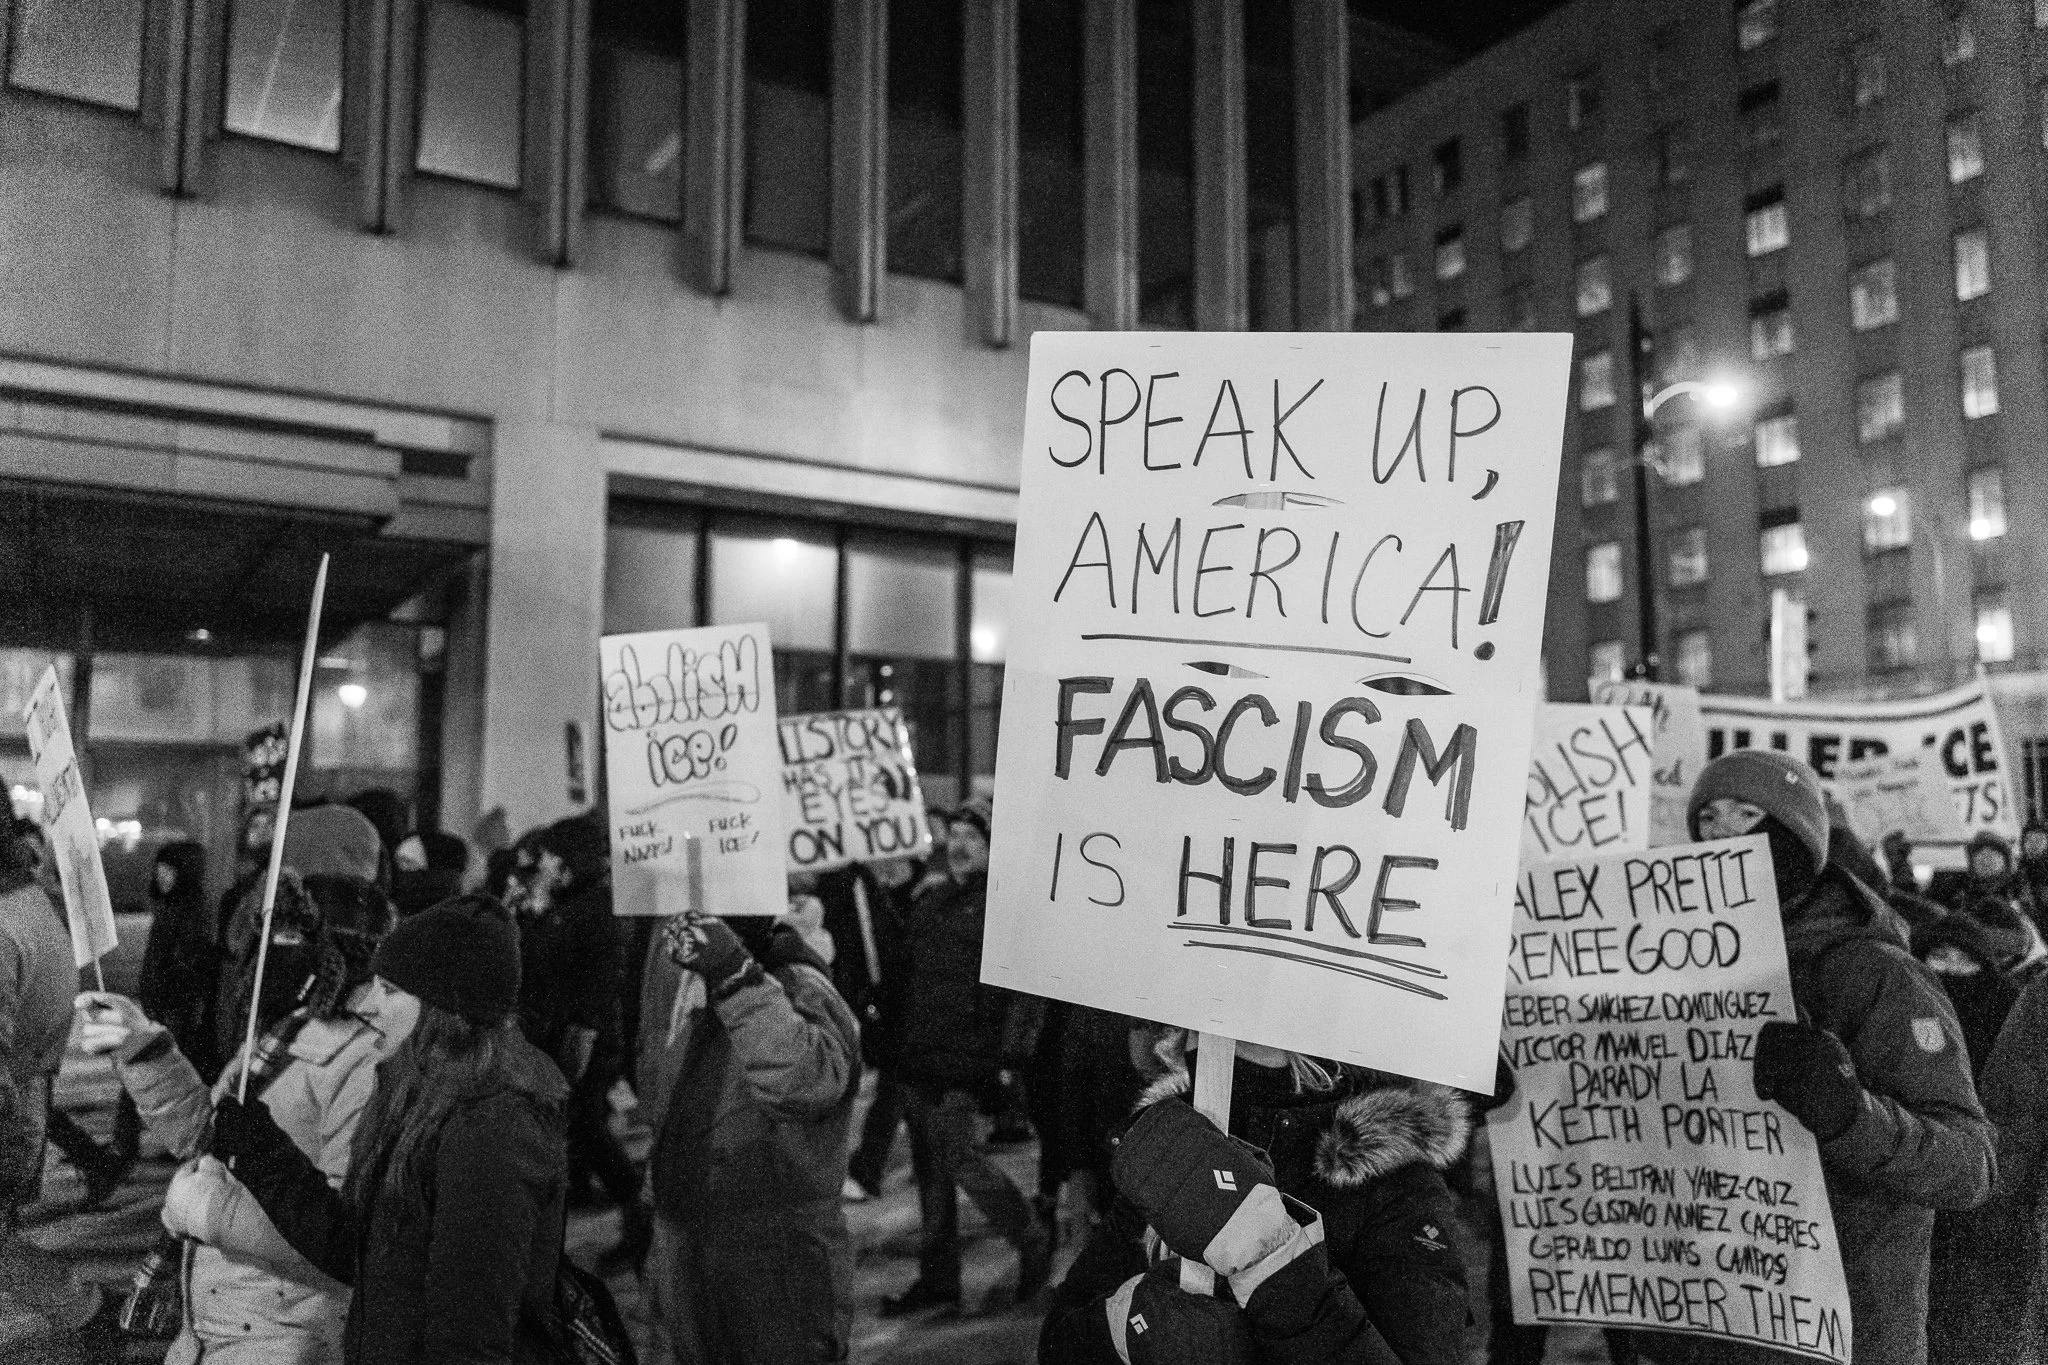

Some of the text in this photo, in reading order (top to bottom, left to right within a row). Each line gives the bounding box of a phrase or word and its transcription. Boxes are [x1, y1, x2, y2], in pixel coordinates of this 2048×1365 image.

[1049, 368, 1501, 500] SPEAK UP,
[1054, 511, 1526, 660] AMERICA!
[777, 709, 901, 765] ISTORY
[1055, 676, 1477, 832] FASCISM
[709, 812, 750, 833] FUCK
[789, 814, 918, 865] ON YOU
[1528, 789, 1629, 853] ICE!
[1050, 832, 1440, 948] IS HERE
[1624, 849, 1757, 918] PRETTI
[1626, 921, 1741, 974] GOOD
[1502, 990, 1778, 1029] EBER SANCHEZ DOMINGUEZ
[1500, 1027, 1755, 1071] VICTOR MANUEL DIAZ
[1569, 1060, 1719, 1106] PARADY LA
[1529, 1099, 1785, 1155] KEITH PORTER
[1510, 1160, 1582, 1195] LUIS
[1592, 1162, 1675, 1197] BELTRAN
[1510, 1198, 1578, 1230] LUIS
[1582, 1196, 1656, 1228] GUSTAVO
[1741, 1210, 1820, 1250] CACERES
[1528, 1234, 1631, 1262] GERALDO
[1642, 1236, 1701, 1267] LUNAS
[1528, 1267, 1846, 1358] REMEMBER THEM
